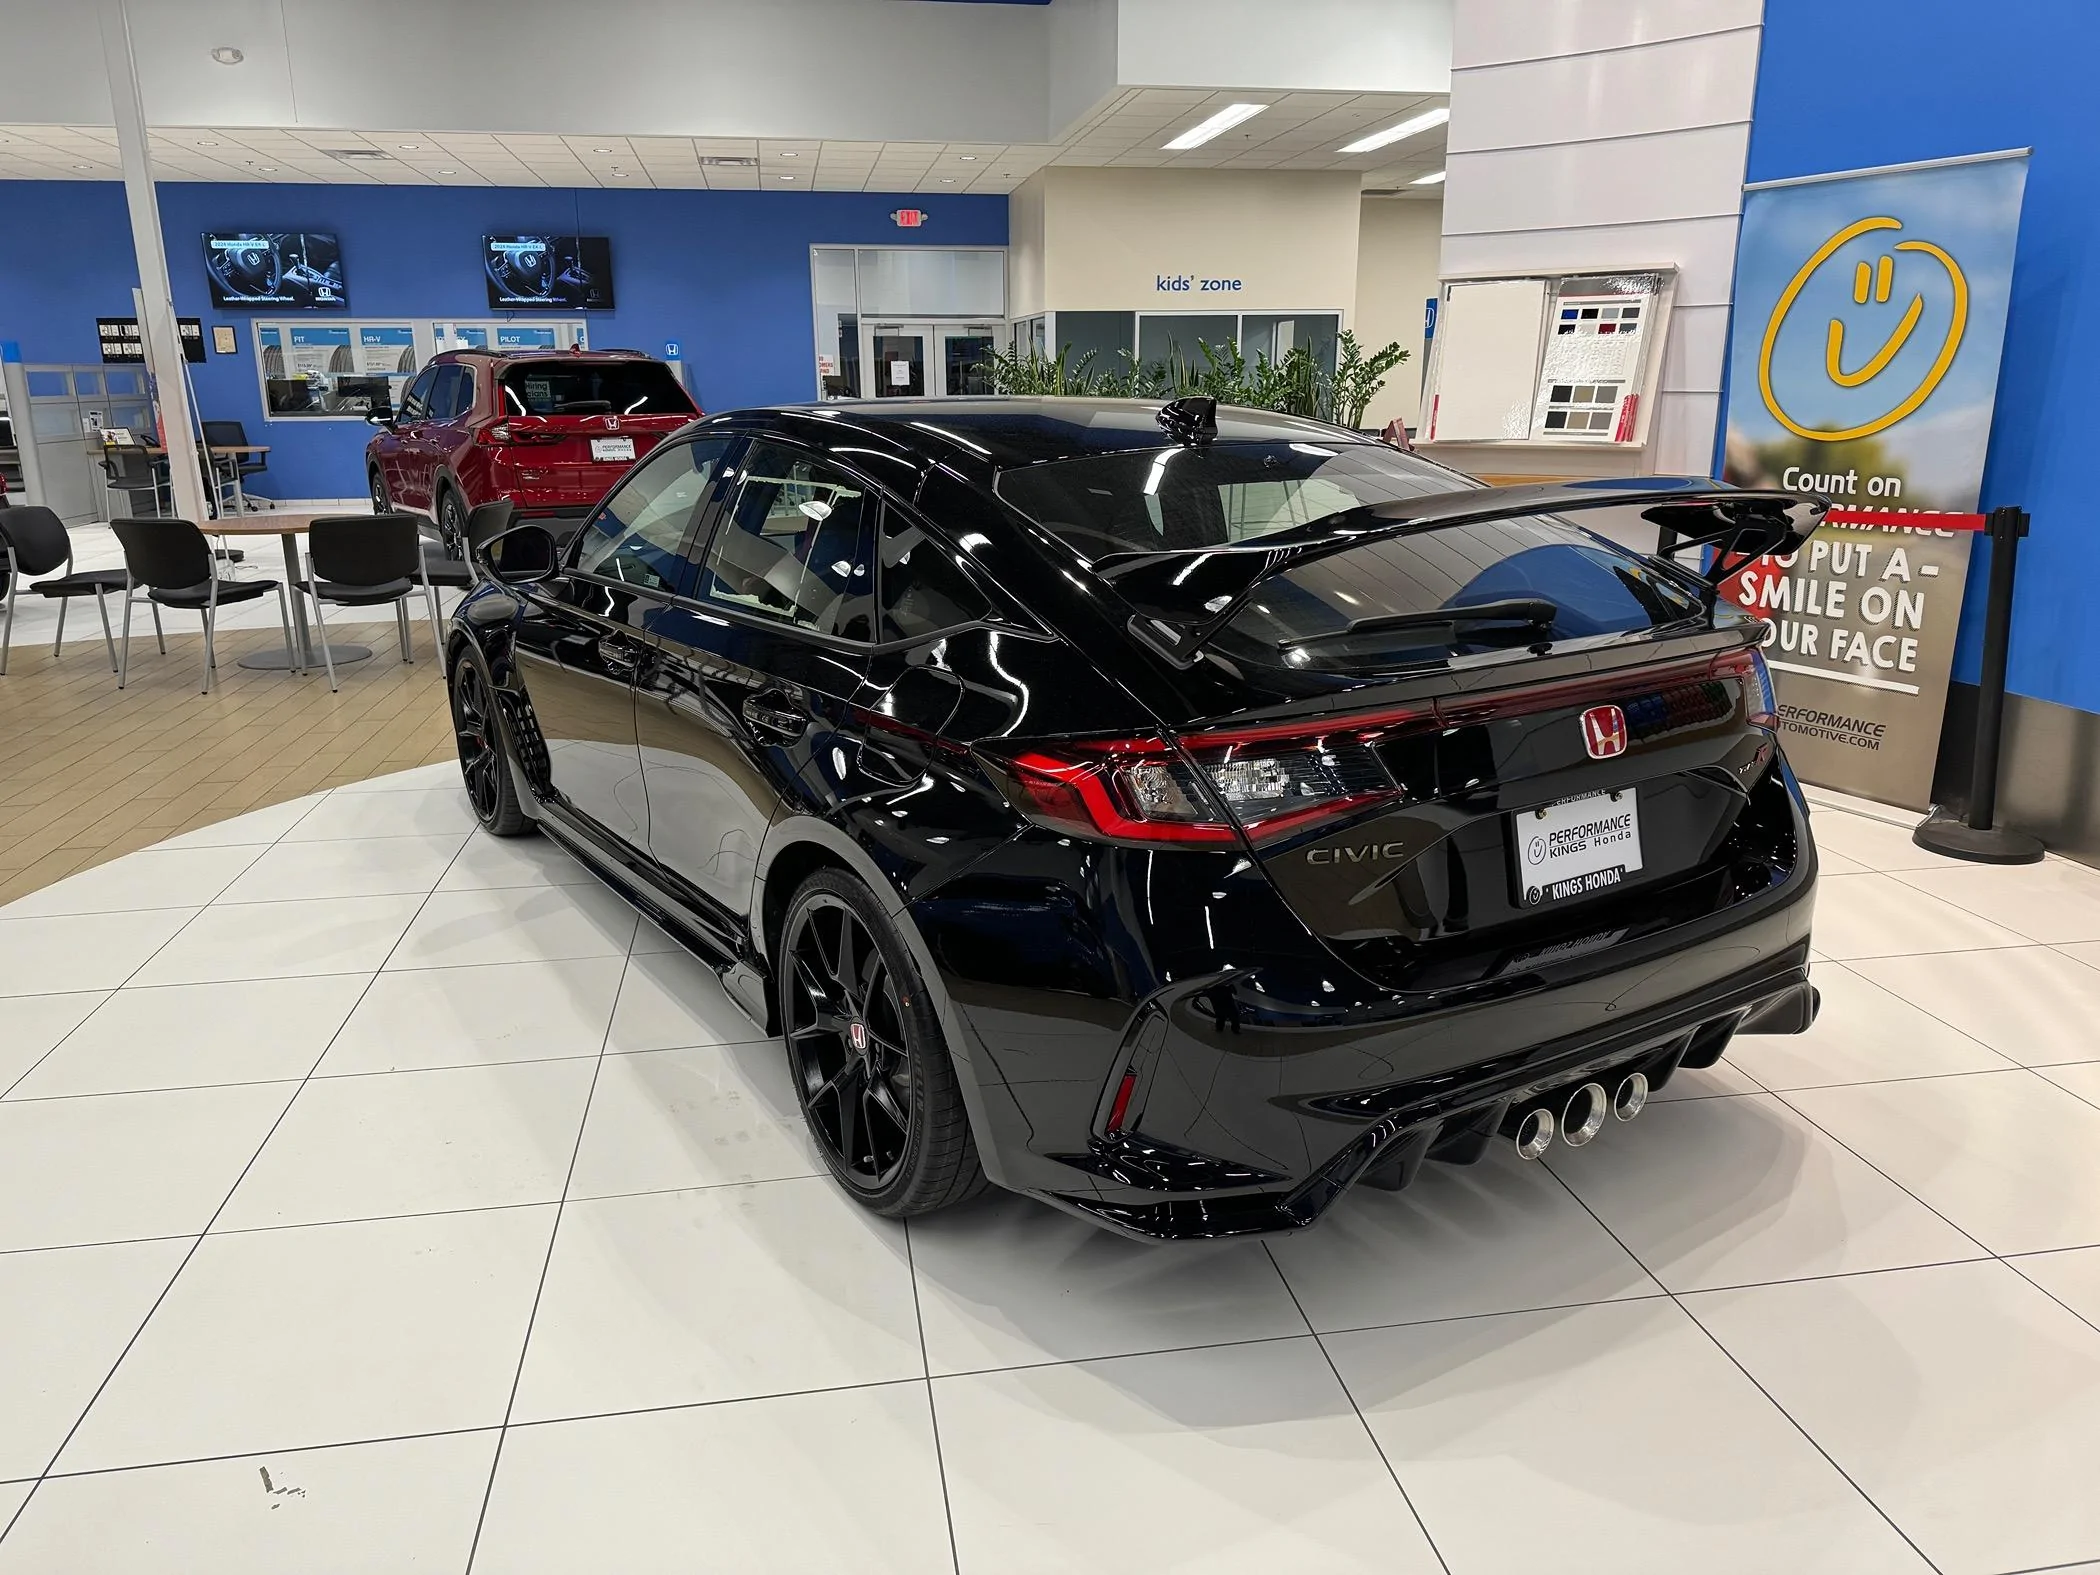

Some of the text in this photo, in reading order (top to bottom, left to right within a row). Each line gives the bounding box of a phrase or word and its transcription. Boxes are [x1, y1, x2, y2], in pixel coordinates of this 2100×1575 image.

[1200, 279, 1242, 291] zone
[500, 335, 521, 343] PILOT
[1783, 466, 1901, 498] Count on
[1810, 540, 1873, 577] PUT
[1882, 548, 1911, 582] A
[1738, 570, 1926, 630] SMILE ON
[1761, 617, 1919, 673] OUR FACE
[1777, 703, 1887, 738] ERFORMANCE
[1781, 720, 1881, 751] TOMOTIVE.COM
[1549, 813, 1631, 846] PERFORMANCE
[1549, 830, 1632, 859] KINGS Honda
[1306, 842, 1404, 865] CIVIC
[1551, 867, 1621, 901] KINGS HONDA
